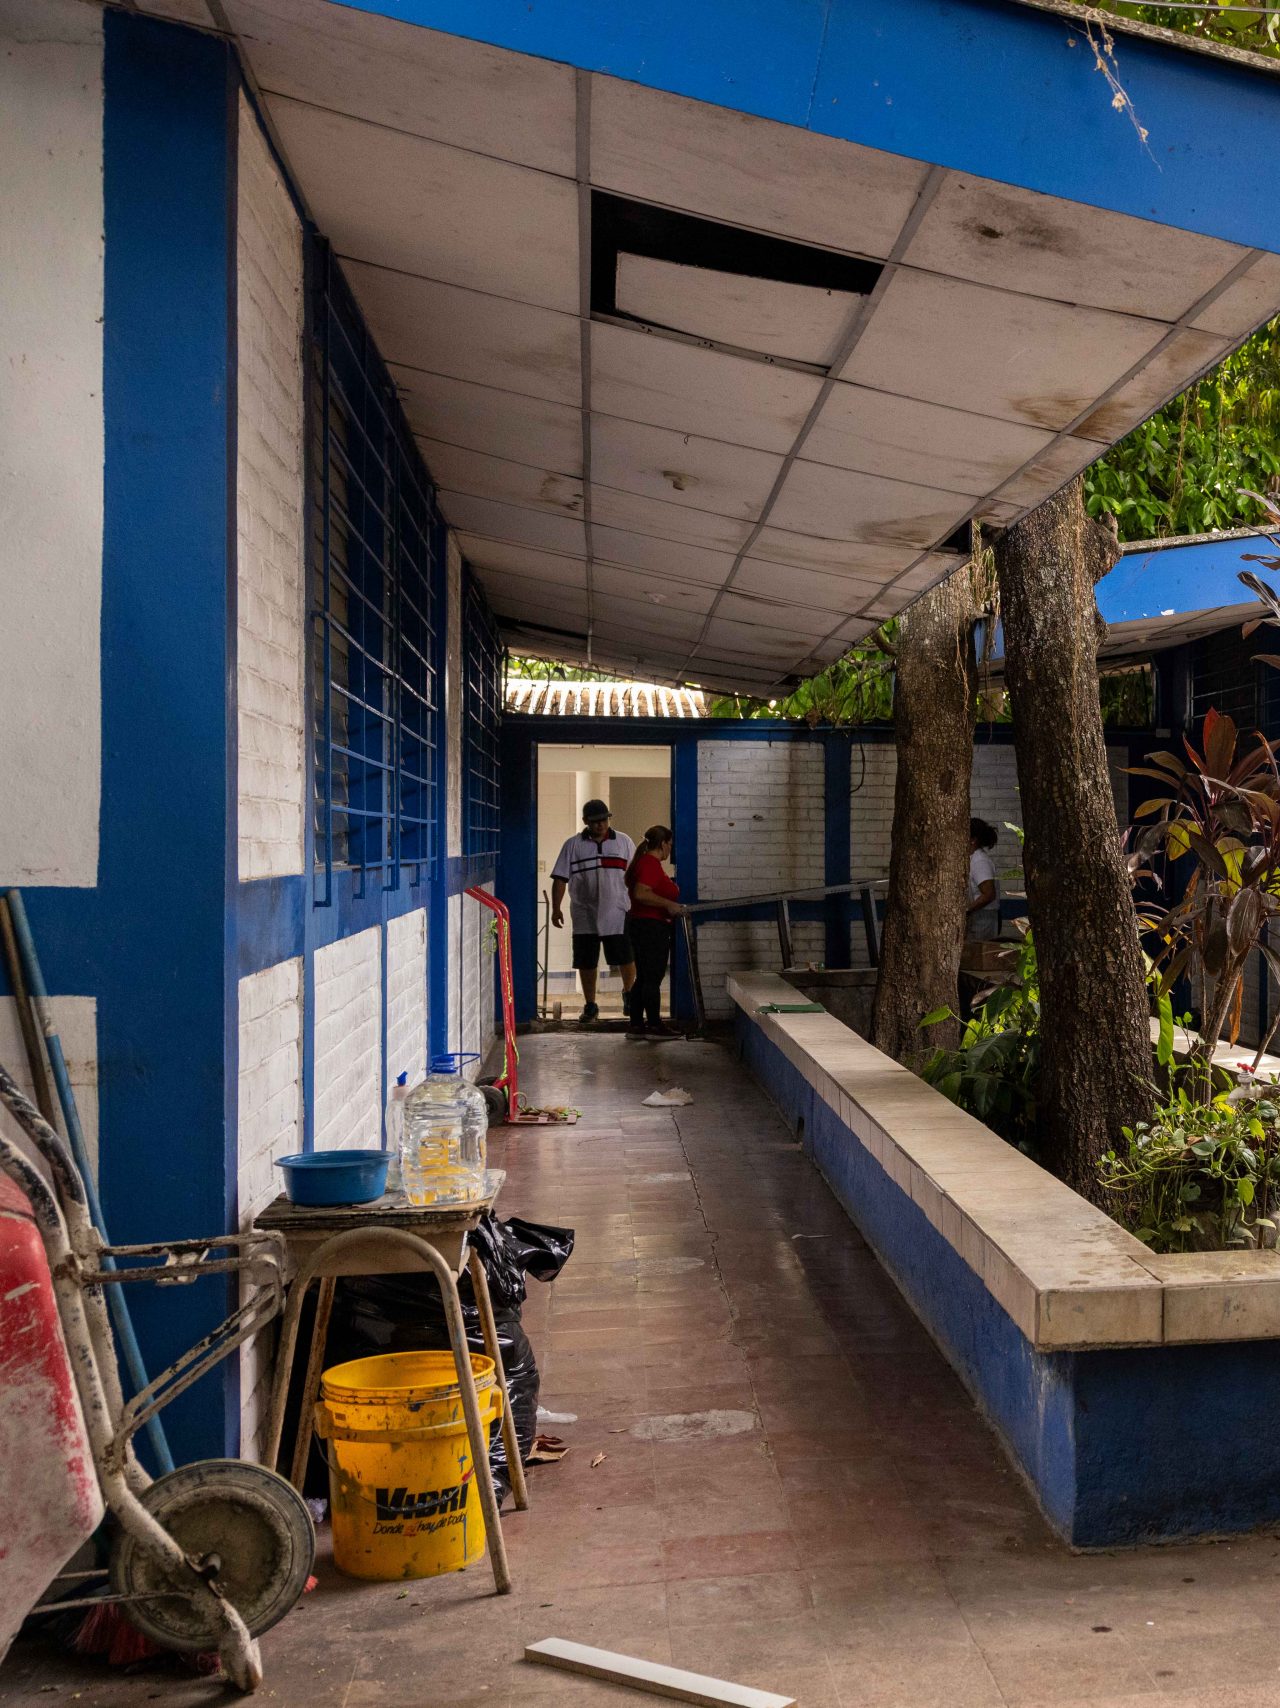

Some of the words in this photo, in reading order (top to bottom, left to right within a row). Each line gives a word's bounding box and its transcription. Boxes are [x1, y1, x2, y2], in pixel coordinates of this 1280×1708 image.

[373, 1522, 404, 1535] Donde
[417, 1520, 436, 1534] hay
[437, 1516, 447, 1528] de
